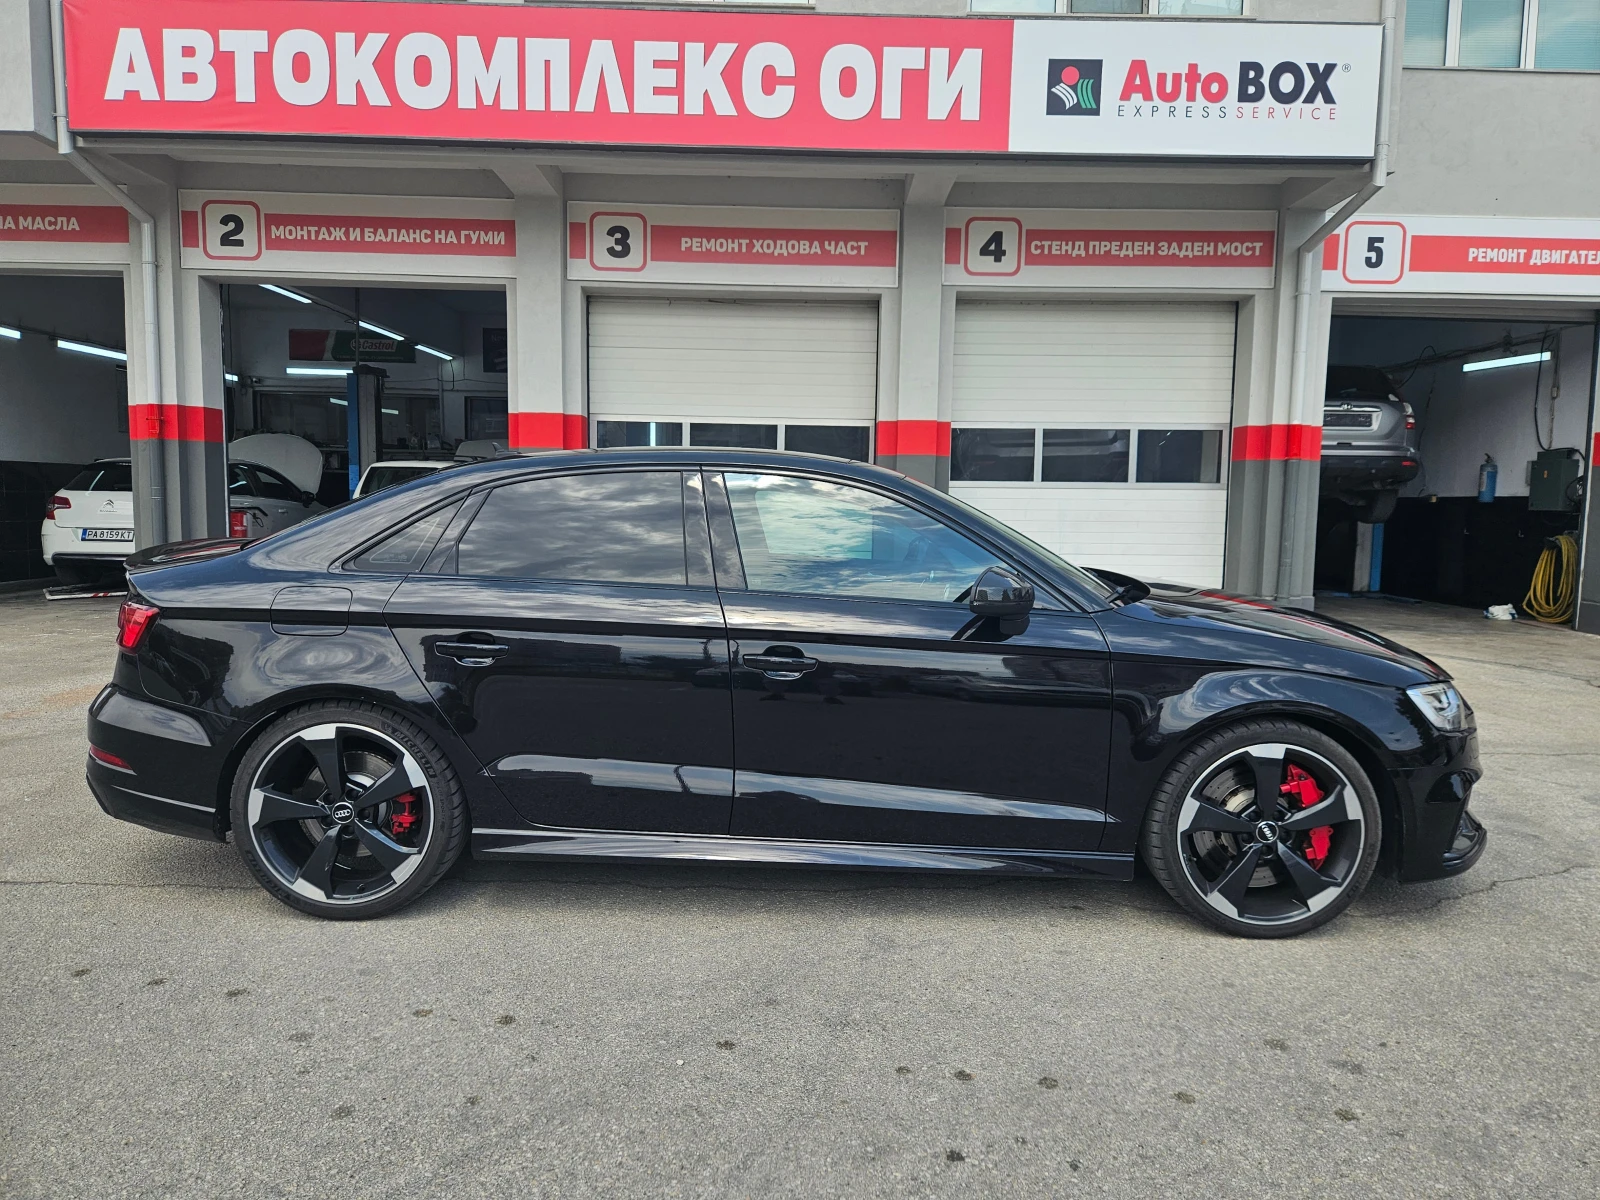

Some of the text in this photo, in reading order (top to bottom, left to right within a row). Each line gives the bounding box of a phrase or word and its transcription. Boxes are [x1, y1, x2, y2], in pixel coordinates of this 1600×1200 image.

[104, 27, 983, 121] АВТОКОМПЛЕКС ОГИ
[1119, 59, 1229, 104] Auto
[1237, 61, 1338, 105] BOX
[1117, 105, 1337, 120] EXPRESS SERVICE
[19, 216, 80, 231] МАСЛА
[219, 214, 245, 247] 2
[270, 225, 506, 245] МОНТАЖ И БАЛАНС НА ГУМИ
[606, 225, 631, 259] 3
[680, 237, 869, 256] РЕМОНТ ХОДОВА ЧАСТ
[979, 230, 1007, 263] 4
[1030, 240, 1263, 257] СТЕНД ПРЕДЕН ЗАДЕН МОСТ
[1364, 236, 1385, 269] 5
[1468, 247, 1527, 264] РЕМОНТ
[362, 340, 395, 351] Castrol
[393, 729, 435, 777] MICHELIN
